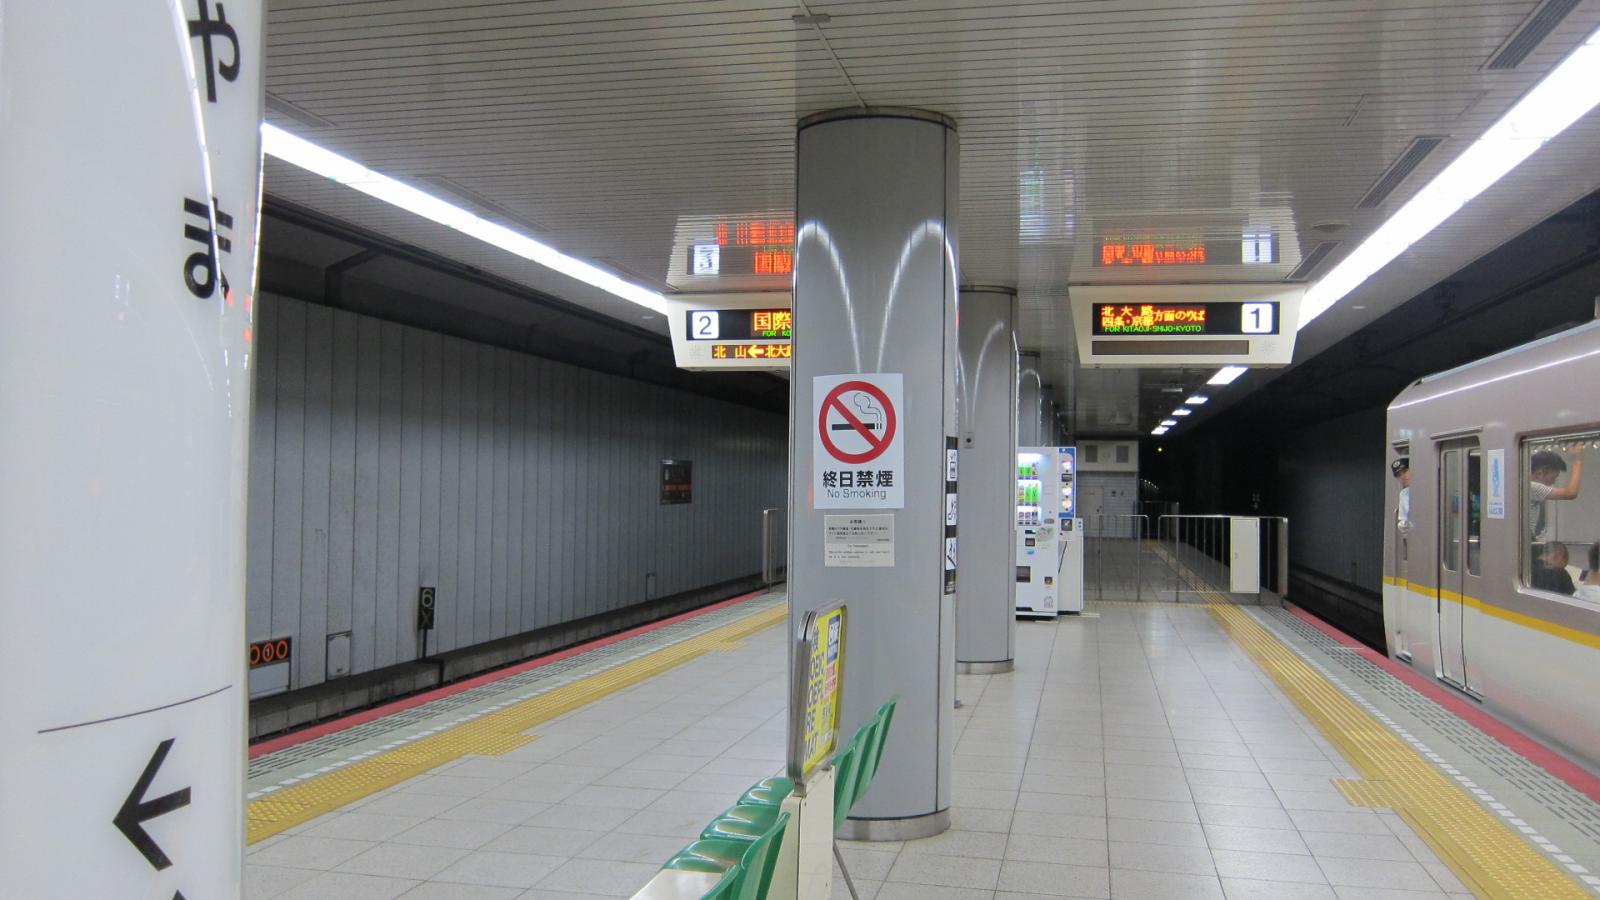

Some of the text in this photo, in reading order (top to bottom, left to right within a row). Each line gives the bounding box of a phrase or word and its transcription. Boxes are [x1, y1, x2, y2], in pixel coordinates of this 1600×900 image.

[699, 315, 712, 335] 2
[1154, 310, 1205, 322] 方面のりば
[1249, 306, 1260, 329] 1
[822, 469, 893, 488] 終日禁煙
[827, 488, 887, 500] No Smoking
